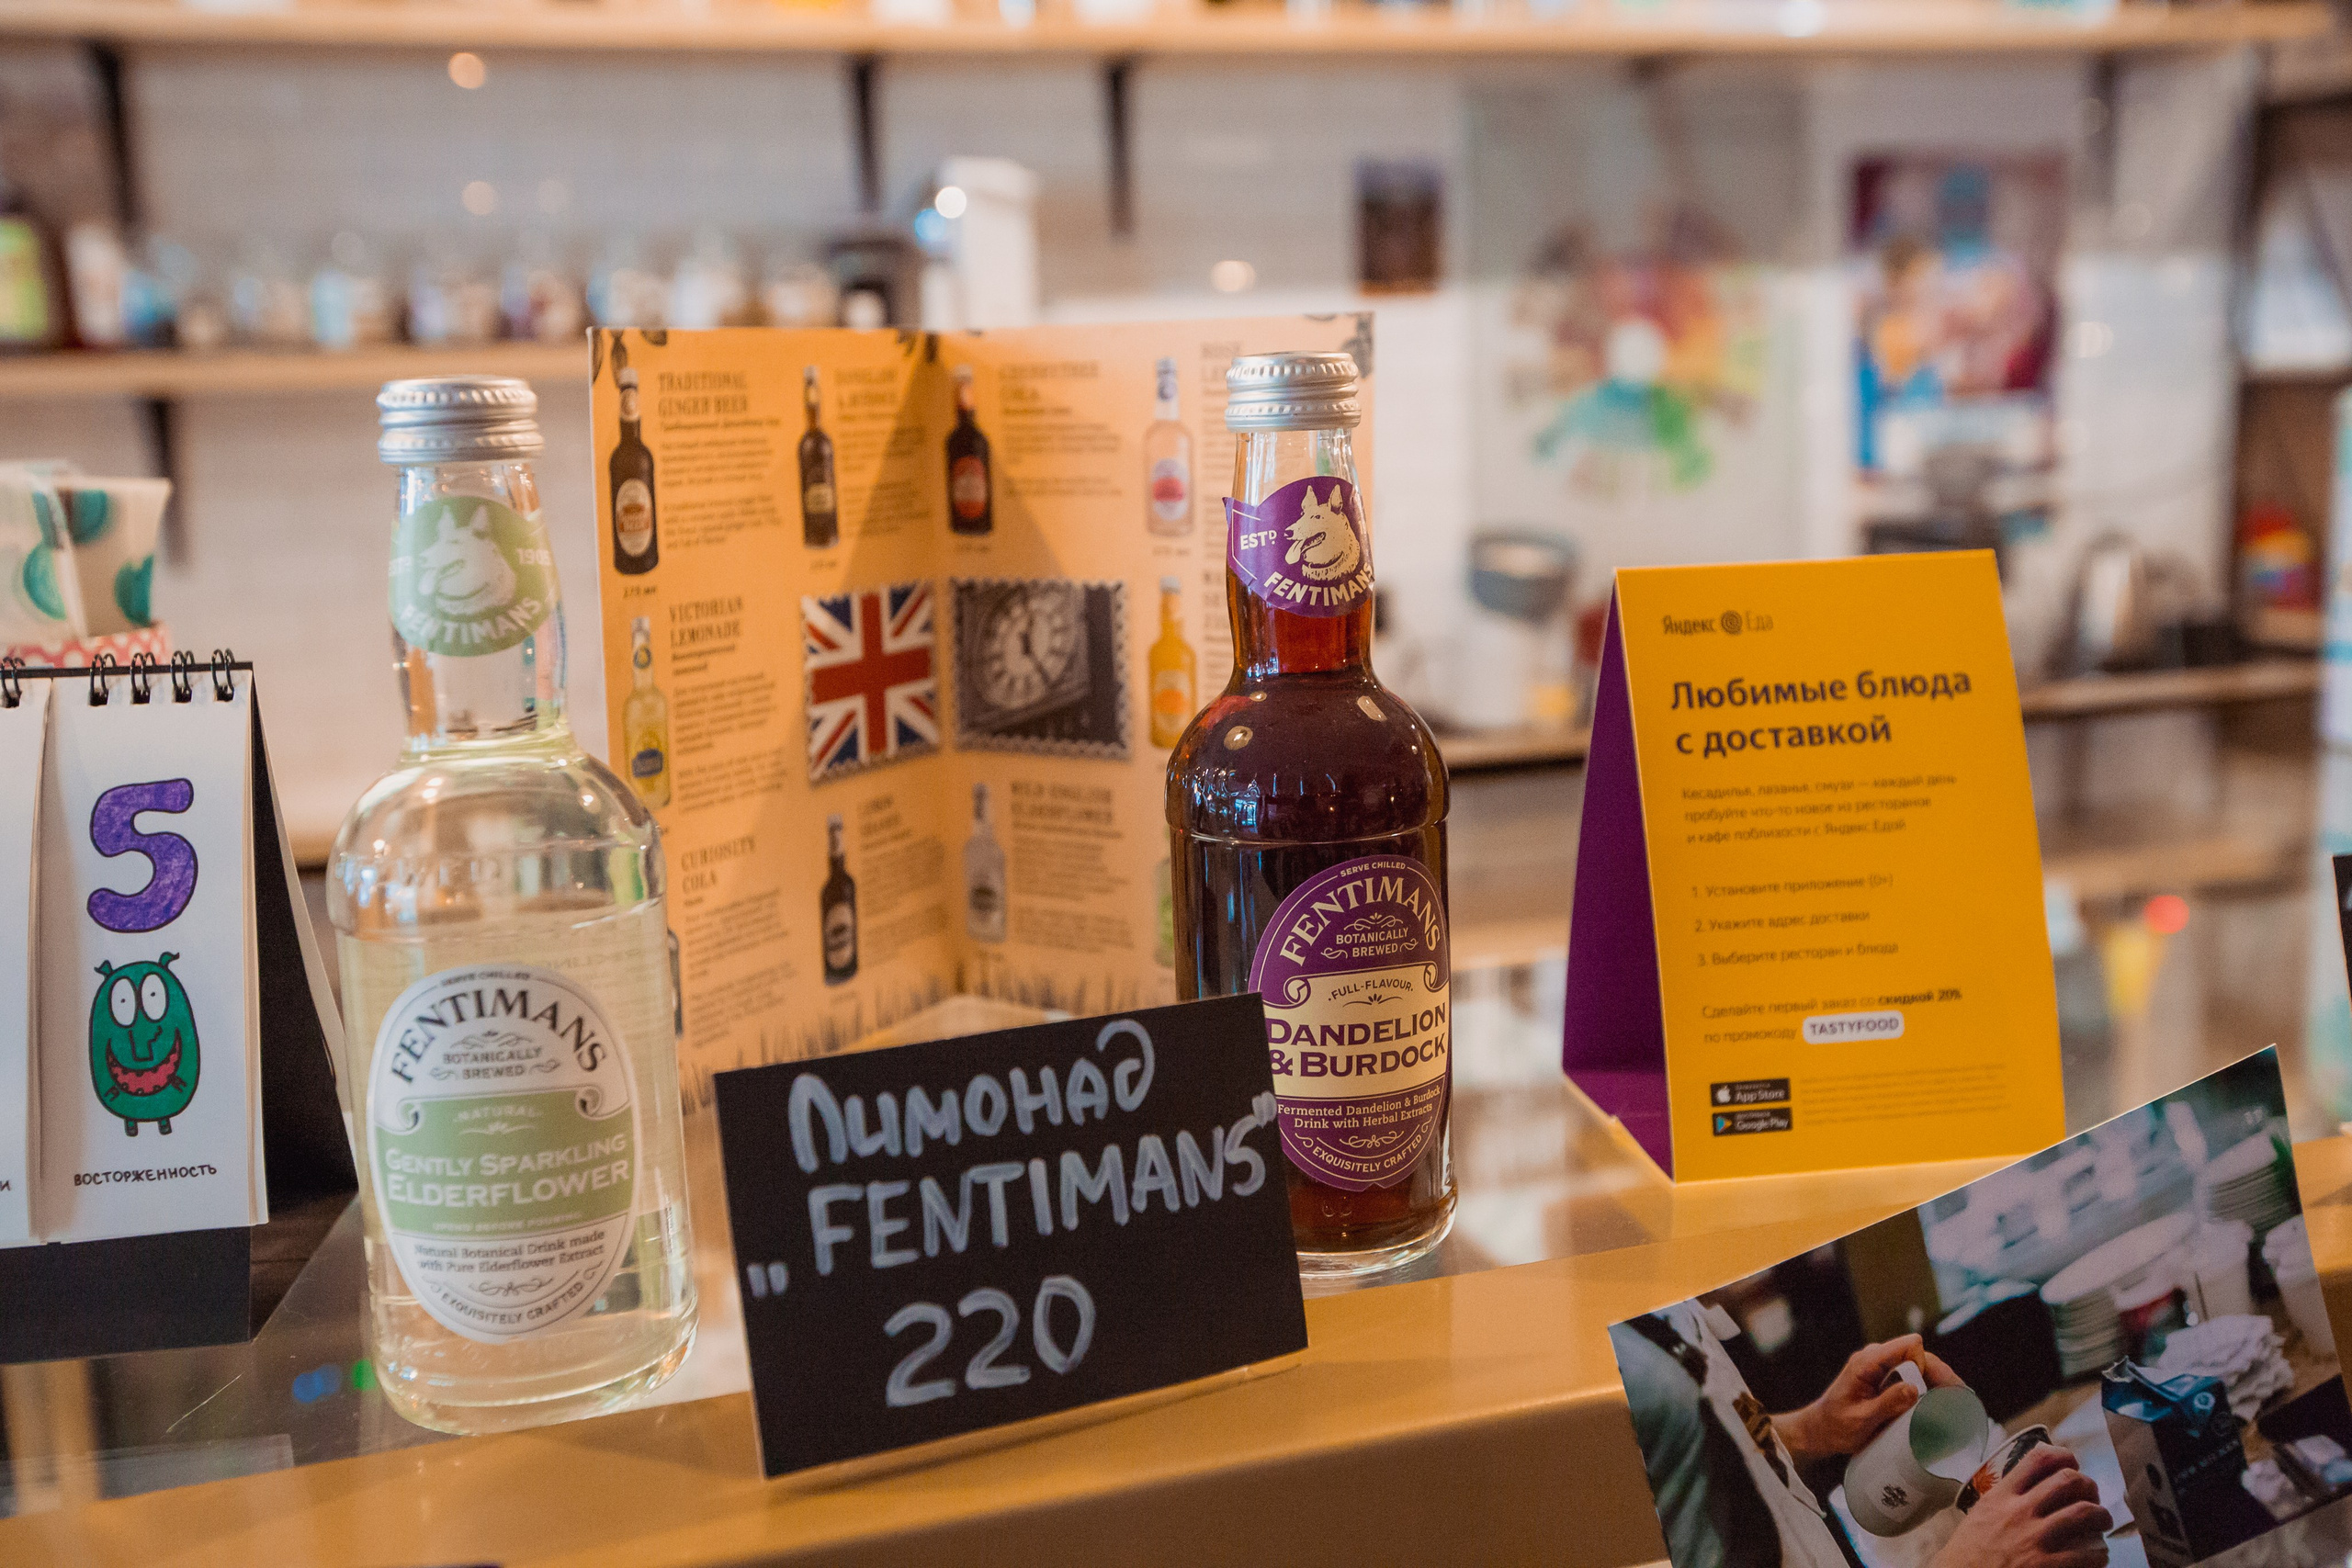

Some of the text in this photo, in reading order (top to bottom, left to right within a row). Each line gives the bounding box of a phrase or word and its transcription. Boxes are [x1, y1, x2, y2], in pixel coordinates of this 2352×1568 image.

[1263, 562, 1374, 607] FENTIMANS
[399, 597, 542, 645] FENTIMANS
[1662, 610, 1774, 637] Яндекс Еда
[1670, 669, 1973, 711] Любимые блюда
[1676, 713, 1893, 761] с доставкой
[1683, 807, 1748, 825] пробуйте
[1698, 829, 1731, 845] кафе
[1734, 825, 1813, 842] поблизости
[86, 777, 199, 934] 5
[1340, 862, 1407, 877] SERVE CHILLED
[1705, 882, 1781, 897] Установите
[1783, 876, 1865, 894] приложение
[1279, 875, 1442, 967] FENTIMANS
[1710, 918, 1765, 931] Укажите
[1768, 915, 1805, 929] адрес
[1810, 910, 1871, 926] доставки
[1335, 927, 1408, 945] BOTANICALLY
[1351, 943, 1398, 958] BREWED
[1712, 950, 1778, 965] Выберите
[1781, 945, 1843, 964] ресторан
[1857, 941, 1900, 955] блюда
[1702, 1002, 1766, 1021] Сделайте
[1768, 998, 1818, 1015] первый
[1877, 989, 1934, 1007] скидкой
[390, 987, 607, 1085] FENTIMANS
[1265, 1002, 1446, 1046] DANDELION
[1723, 1027, 1797, 1044] промокоду
[1809, 1017, 1900, 1037] TASTYFOOD
[443, 1045, 543, 1066] BOTANICALLY
[1271, 1032, 1446, 1077] & BURDOCK
[462, 1065, 526, 1080] BREWED
[1277, 1084, 1441, 1116] Fermented Dandelion & Burdock
[1294, 1101, 1433, 1129] Drink with Herbal Extracts
[1312, 1134, 1423, 1173] EXQUISITELY CRAFTED
[74, 1164, 218, 1187] ВОСТОРЖЕННОСТЬ
[414, 1229, 606, 1259] Natural Botanical Drink made
[418, 1244, 605, 1274] with Pure Elderflower Extract
[441, 1280, 586, 1325] EXQUISITELY CRAFTED
[884, 1274, 1097, 1408] 220
